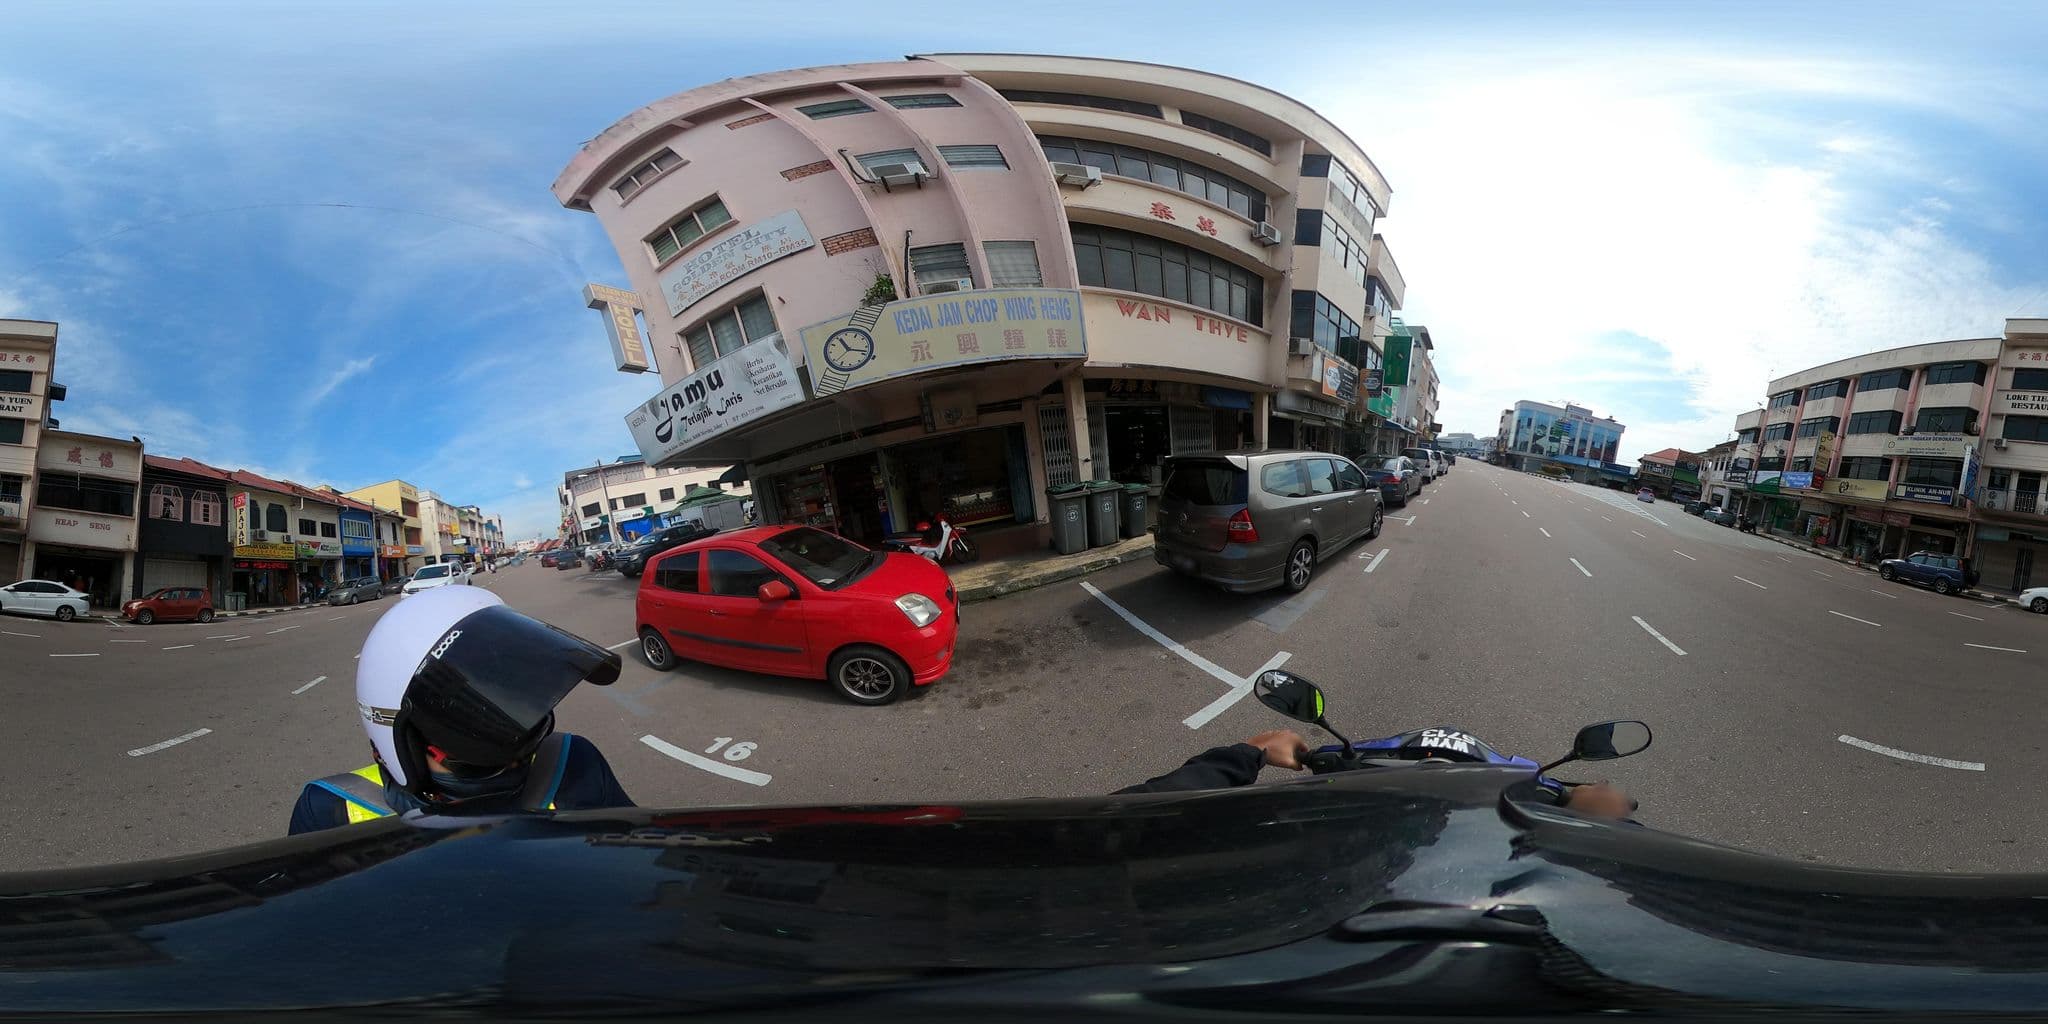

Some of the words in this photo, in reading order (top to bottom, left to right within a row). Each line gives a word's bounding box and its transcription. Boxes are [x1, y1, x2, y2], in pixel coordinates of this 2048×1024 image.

[682, 228, 761, 275] HOTEL
[893, 305, 932, 334] KEDAI
[937, 301, 964, 326] JAM
[967, 298, 998, 323] CHOP
[1004, 296, 1036, 320] WING
[1040, 298, 1072, 320] HENG
[1116, 300, 1171, 324] WAN
[1193, 314, 1248, 343] THYE
[612, 304, 646, 365] HOTEL
[55, 518, 78, 526] HEAP
[90, 522, 110, 530] SENG
[704, 736, 758, 761] 16
[1421, 736, 1469, 754] WYM
